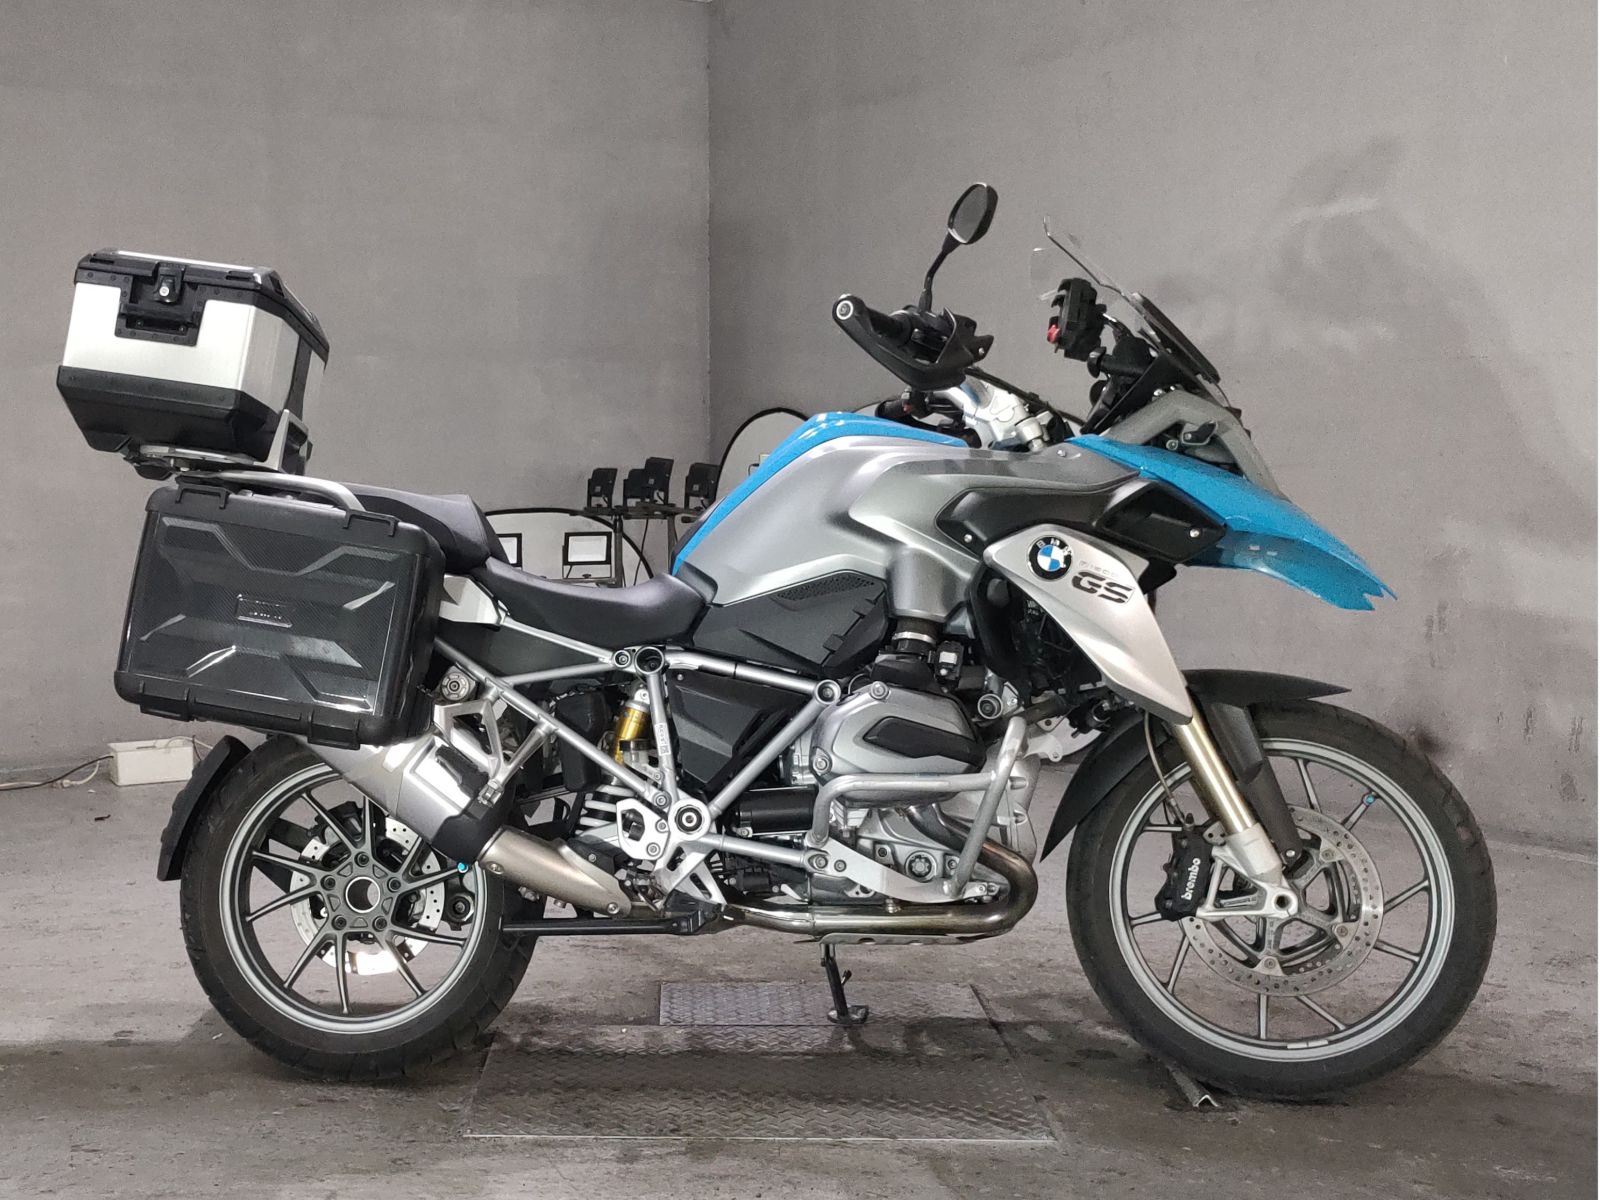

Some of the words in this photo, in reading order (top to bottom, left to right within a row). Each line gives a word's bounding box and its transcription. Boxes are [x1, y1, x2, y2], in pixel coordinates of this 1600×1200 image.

[1036, 538, 1072, 556] BMW
[1072, 571, 1132, 603] GS
[1181, 857, 1201, 901] brembo
